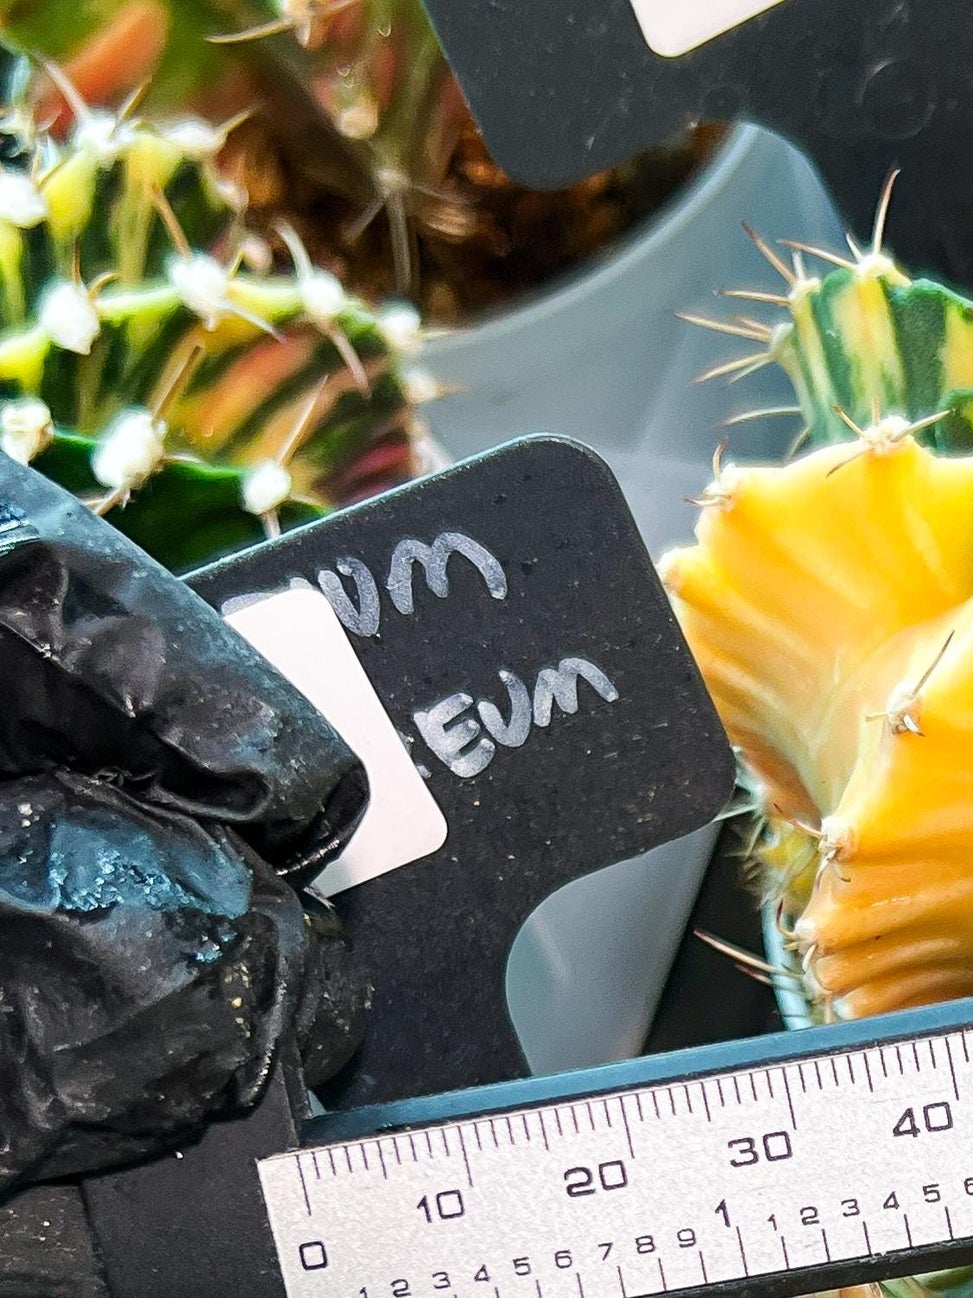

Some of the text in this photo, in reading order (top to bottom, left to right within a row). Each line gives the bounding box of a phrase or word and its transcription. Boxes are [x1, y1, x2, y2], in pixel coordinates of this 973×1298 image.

[299, 1241, 328, 1270] 0
[416, 1189, 465, 1223] 10
[563, 1160, 628, 1198] 20
[727, 1130, 793, 1168] 30
[892, 1101, 954, 1138] 40
[390, 1279, 412, 1298] 2
[431, 1271, 451, 1290] 3
[473, 1264, 491, 1283] 4
[512, 1256, 532, 1277] 5
[554, 1250, 573, 1269] 6
[597, 1241, 614, 1262] 7
[635, 1235, 657, 1255] 8
[677, 1227, 696, 1248] 9
[714, 1199, 731, 1228] 1
[767, 1213, 778, 1231] 1
[800, 1206, 820, 1226] 2
[840, 1199, 861, 1217] 3
[882, 1191, 901, 1210] 4
[922, 1183, 942, 1203] 5
